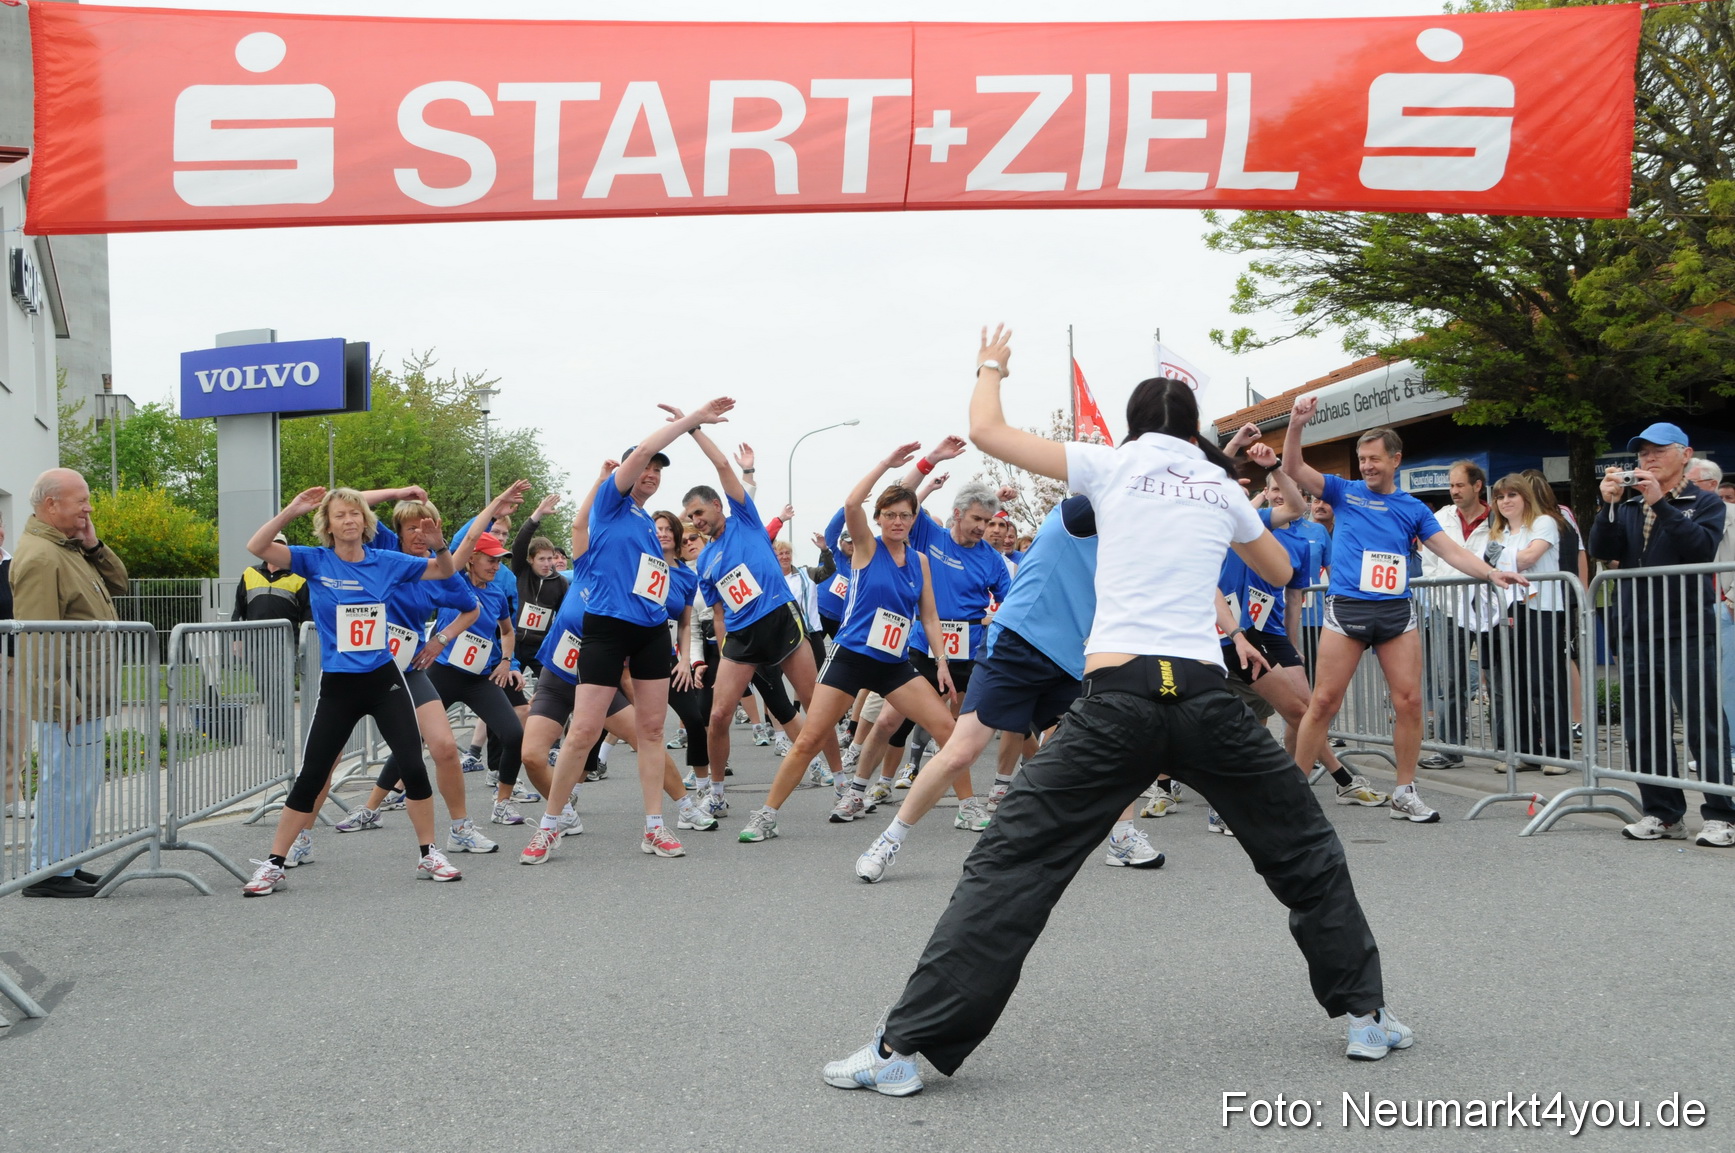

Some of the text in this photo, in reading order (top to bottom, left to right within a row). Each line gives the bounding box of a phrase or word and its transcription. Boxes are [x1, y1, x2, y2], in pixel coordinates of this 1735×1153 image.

[194, 360, 321, 394] VOLVO
[1303, 402, 1351, 428] utohaus
[1354, 384, 1400, 413] Gerhart
[1404, 378, 1415, 398] &
[1126, 475, 1230, 510] ZEITLOS
[648, 557, 666, 568] MEYER
[1371, 553, 1391, 561] MEYER
[647, 570, 667, 599] 21
[720, 573, 734, 587] MEYER
[1371, 565, 1398, 590] 66
[728, 578, 753, 605] 64
[345, 606, 369, 614] MEYER
[525, 612, 542, 628] 81
[883, 611, 902, 622] MEYER
[349, 619, 376, 647] 67
[465, 633, 485, 645] MEYER
[881, 624, 902, 650] 10
[463, 645, 479, 667] 6
